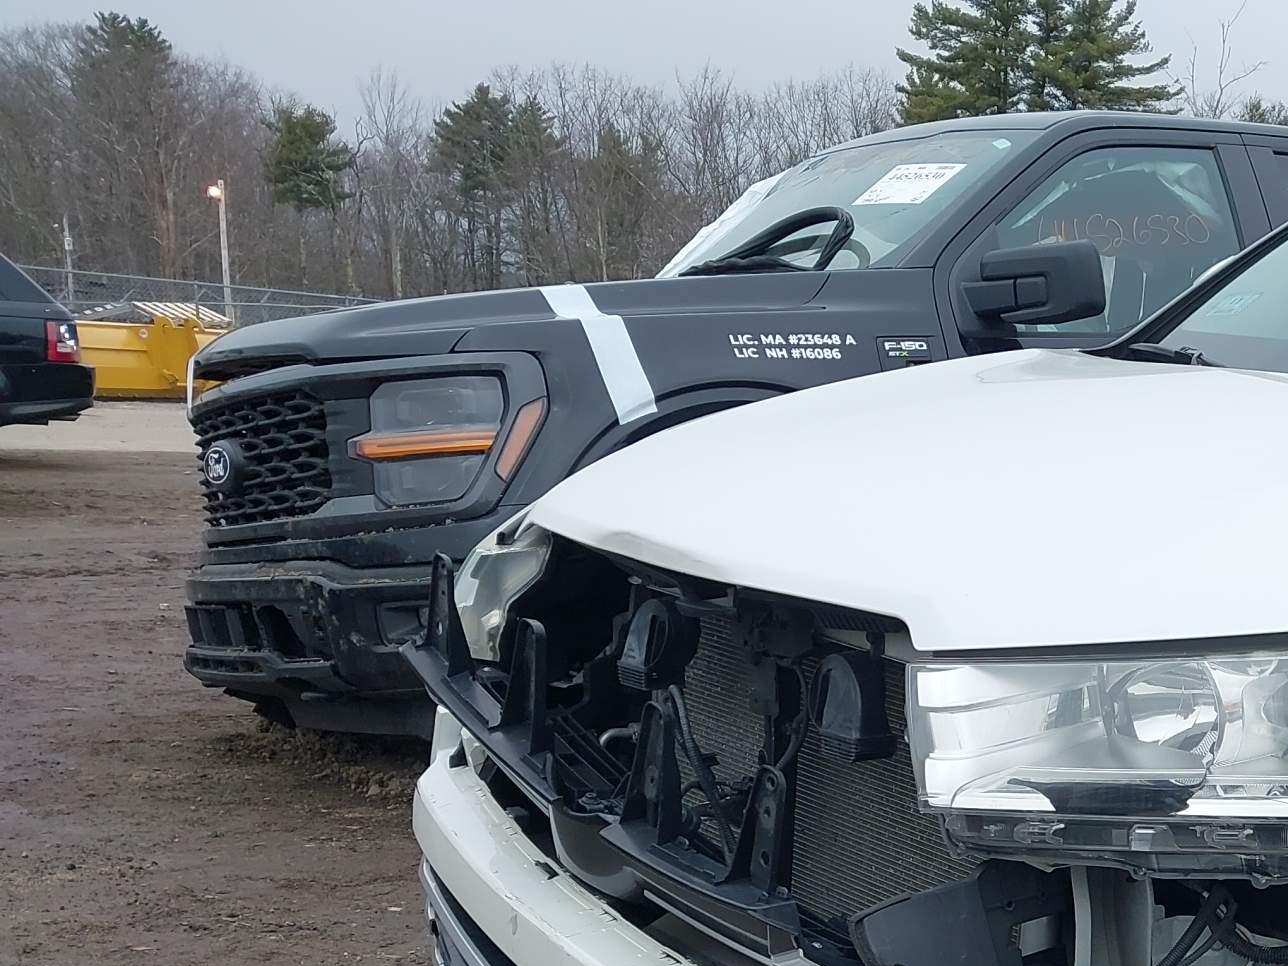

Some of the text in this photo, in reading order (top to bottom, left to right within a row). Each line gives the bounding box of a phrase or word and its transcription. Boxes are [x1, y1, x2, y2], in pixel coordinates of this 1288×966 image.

[728, 334, 857, 346] LIC. MA #23648 A
[884, 341, 928, 351] F-150
[733, 348, 842, 360] LIC NH #16086
[207, 453, 226, 478] Ford
